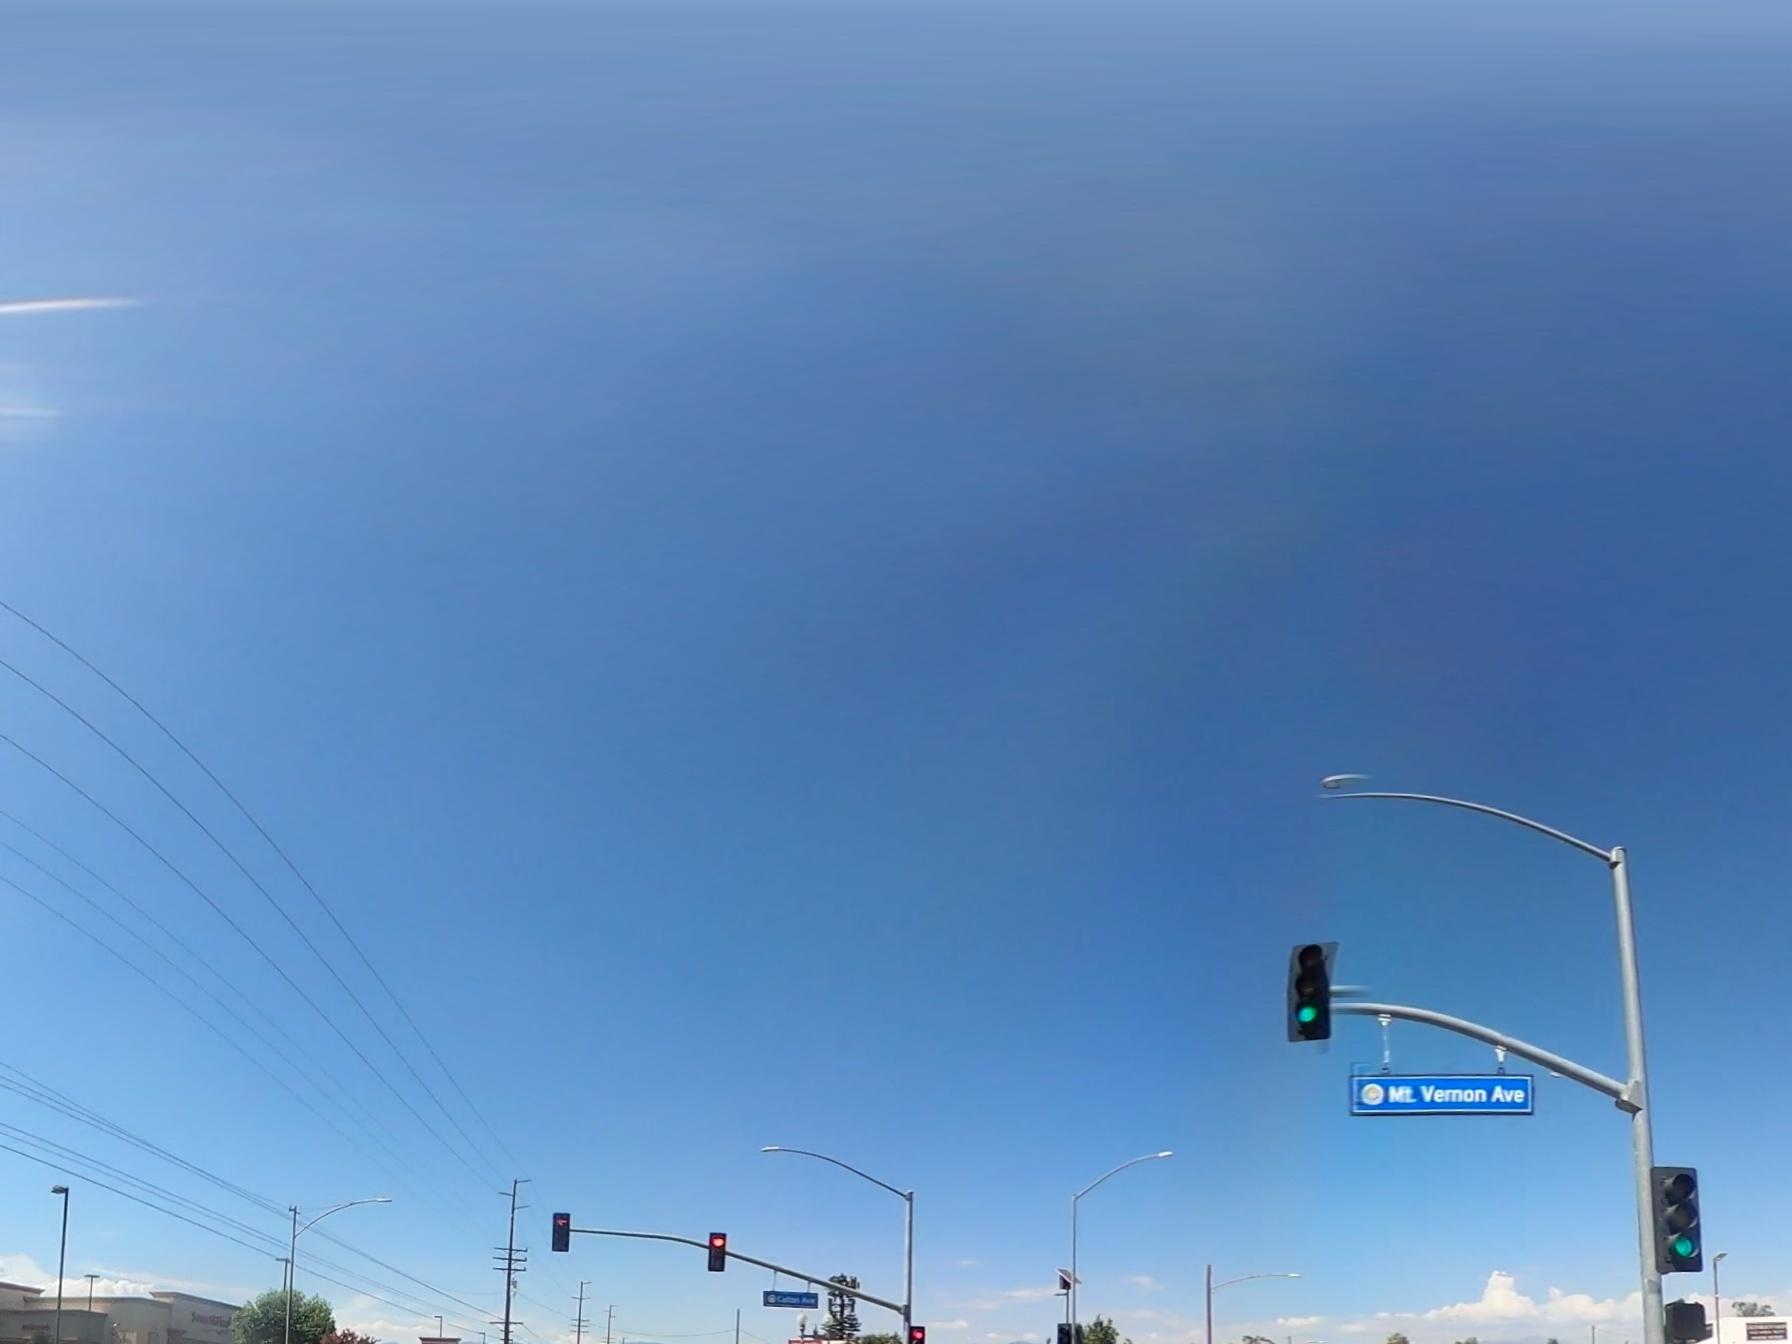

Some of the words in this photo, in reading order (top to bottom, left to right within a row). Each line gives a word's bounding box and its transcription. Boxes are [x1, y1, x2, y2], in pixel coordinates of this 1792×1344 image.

[1388, 1085, 1417, 1103] Mt.
[1420, 1085, 1487, 1103] Vernon
[1491, 1085, 1525, 1103] Ave
